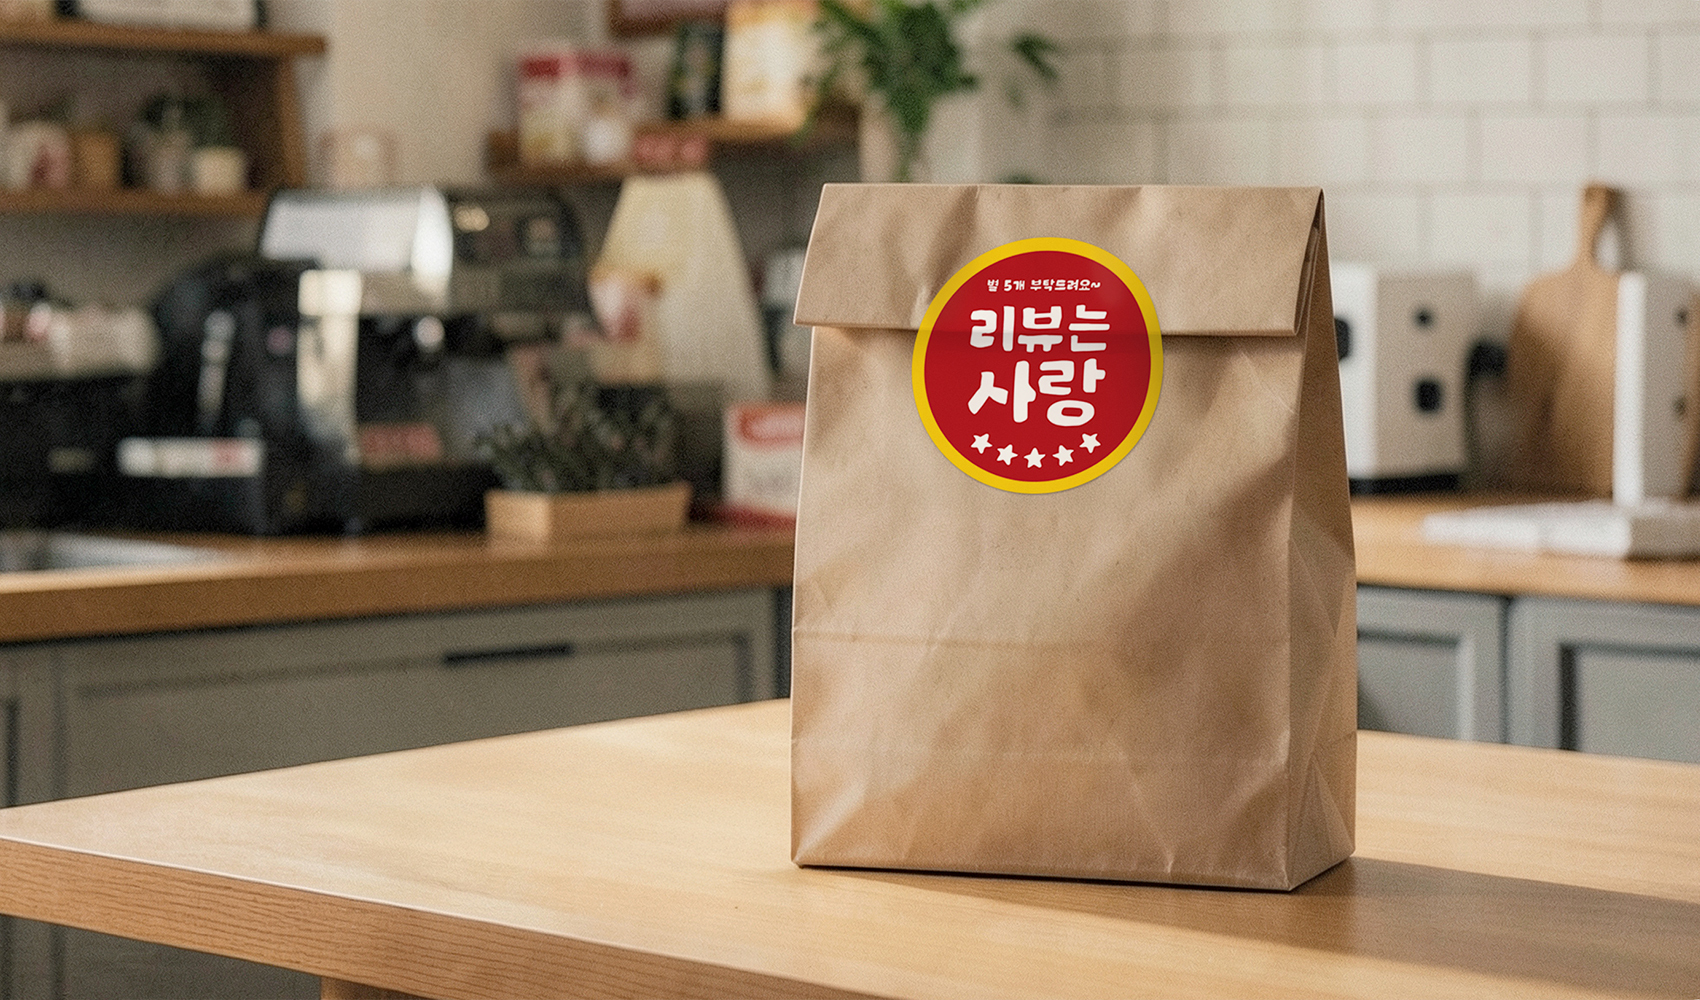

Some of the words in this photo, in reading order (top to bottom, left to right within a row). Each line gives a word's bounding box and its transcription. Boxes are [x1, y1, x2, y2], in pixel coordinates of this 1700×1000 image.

[987, 279, 999, 292] 별
[1003, 279, 1025, 292] 5개
[1030, 279, 1101, 292] 부탁드려요~
[970, 304, 1110, 353] 리뷰는
[967, 358, 1107, 427] 사랑
